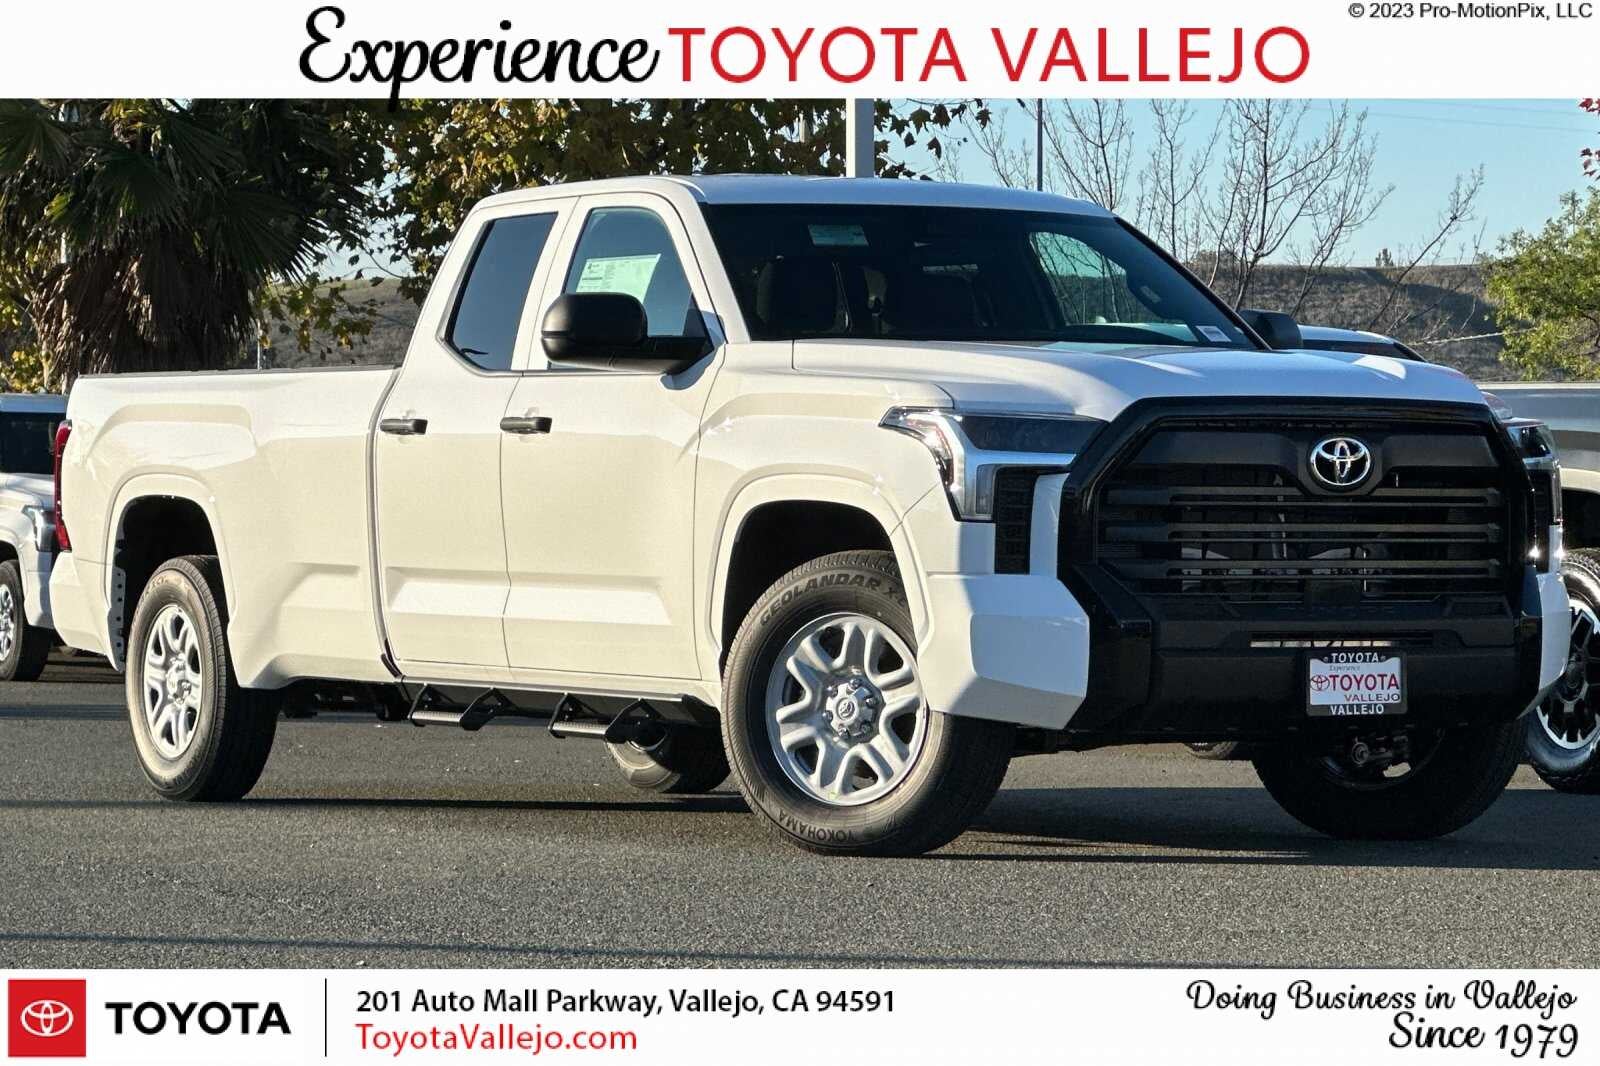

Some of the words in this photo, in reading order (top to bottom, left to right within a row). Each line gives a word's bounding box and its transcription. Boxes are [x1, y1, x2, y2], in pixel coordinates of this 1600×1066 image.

[760, 573, 881, 626] GEOLANDAR
[1331, 653, 1379, 663] TOYOTA
[1328, 673, 1400, 692] TOYOTA
[1344, 693, 1400, 702] VALLEJO
[1330, 704, 1384, 715] VALLEJO
[778, 809, 857, 842] YOKOHAMA
